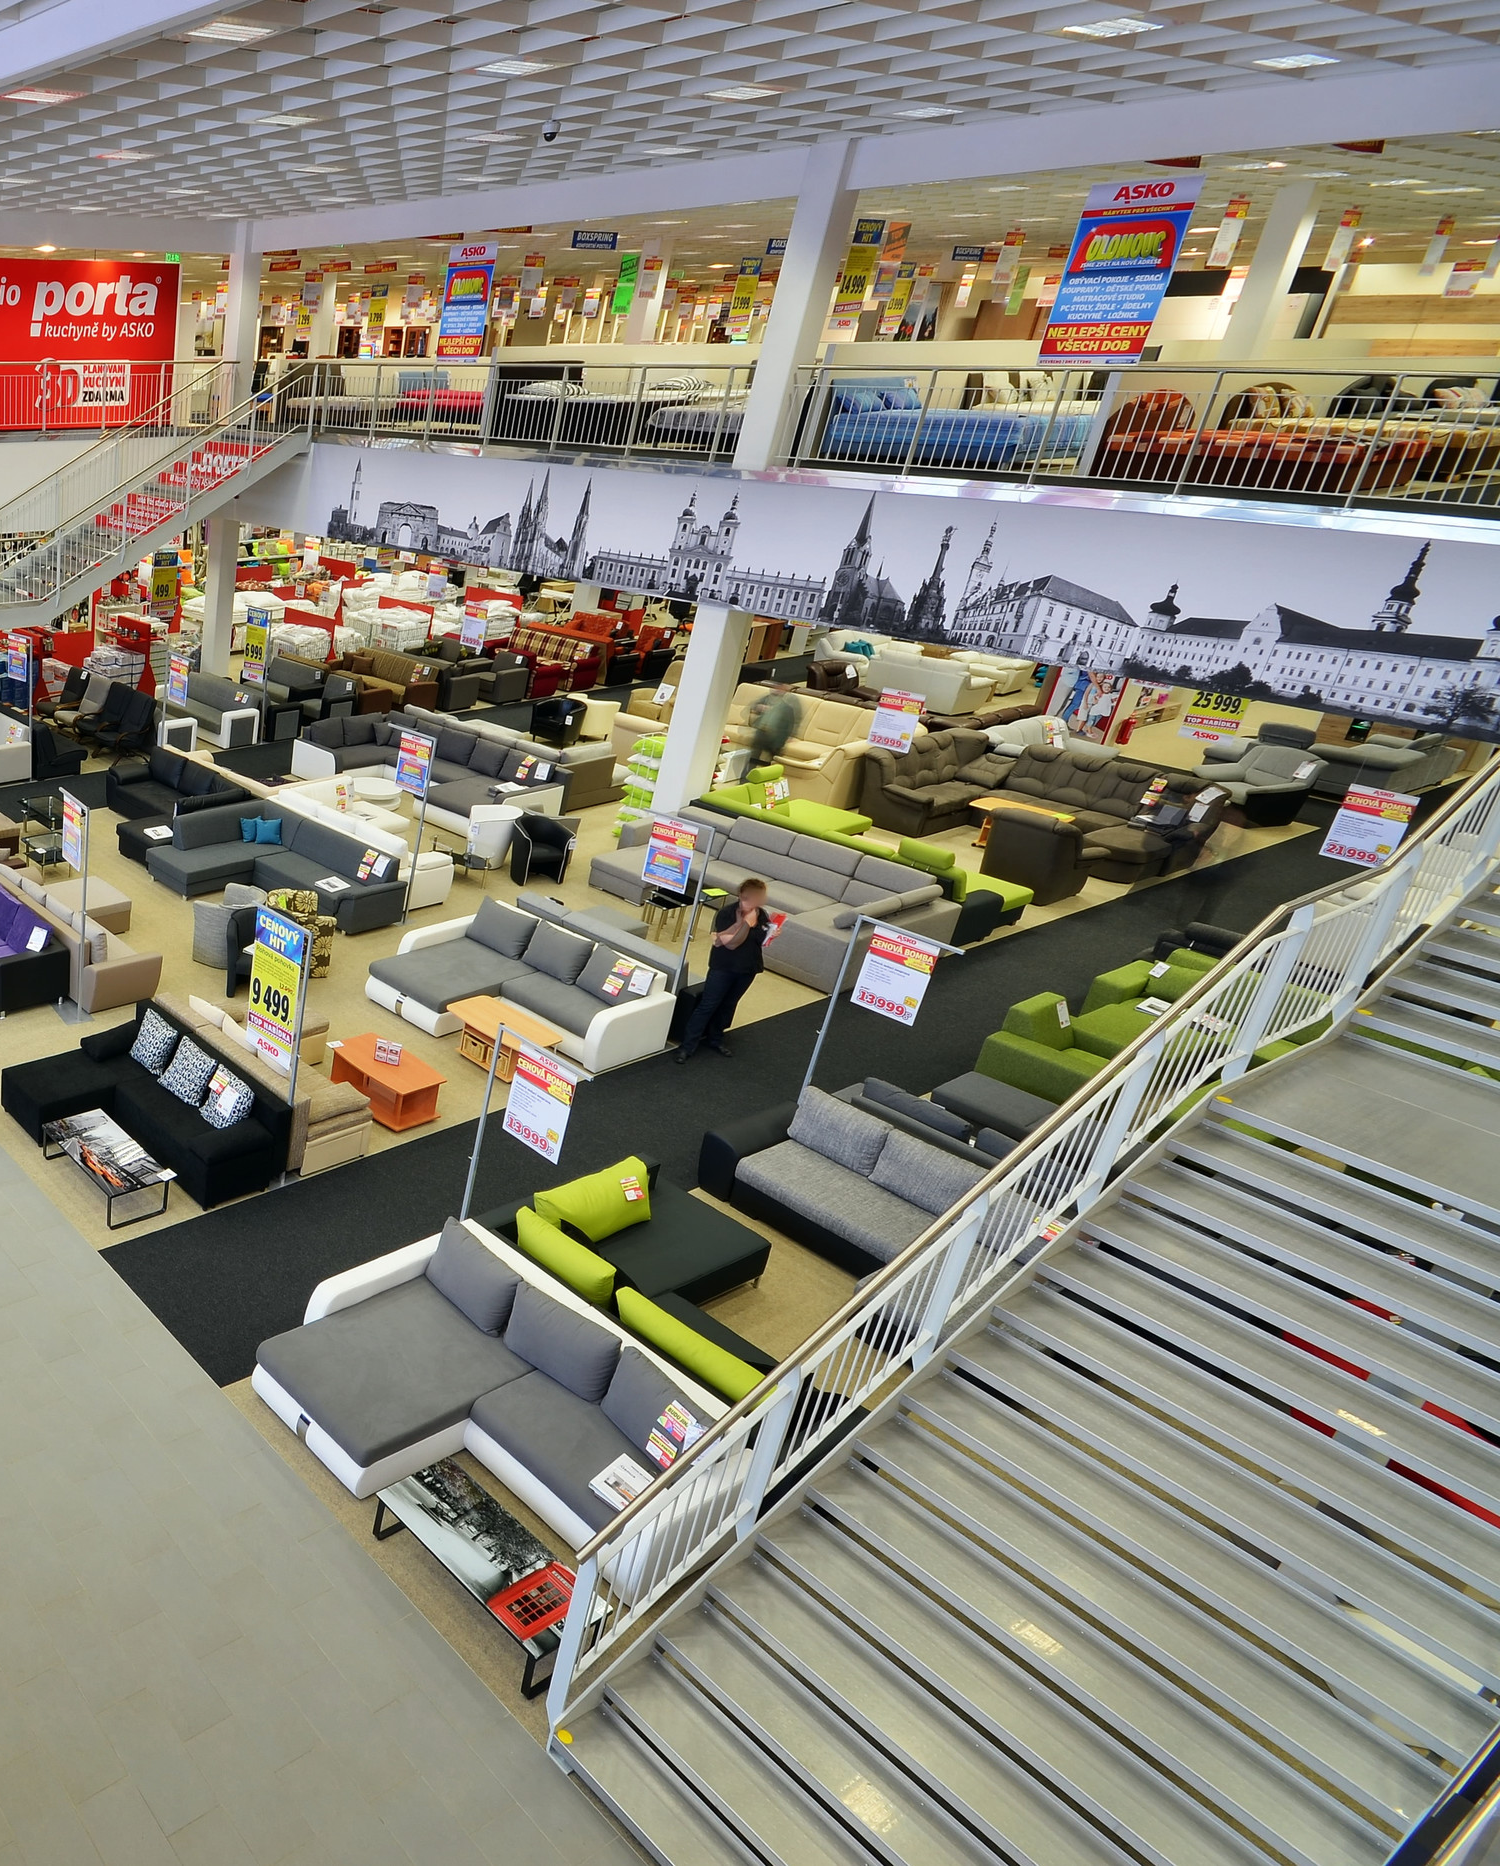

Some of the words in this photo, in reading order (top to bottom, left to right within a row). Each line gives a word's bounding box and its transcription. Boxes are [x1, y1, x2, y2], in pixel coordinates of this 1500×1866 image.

[1113, 182, 1175, 203] ASKO
[858, 222, 883, 232] CENOVÝ
[577, 232, 614, 242] BOXSPRING
[861, 233, 873, 243] HIT
[461, 246, 486, 259] ASKO
[1086, 231, 1167, 261] OLOMOUC
[1135, 273, 1163, 282] SEDACÍ
[32, 275, 158, 321] porta
[45, 322, 98, 341] kuchyně
[102, 322, 117, 341] by
[119, 323, 154, 337] ASKO
[1048, 323, 1110, 338] NEJLEPŠÍ
[1111, 325, 1150, 337] CENY
[1056, 339, 1098, 352] VŠECH
[1101, 340, 1131, 351] DOB
[83, 391, 125, 402] ZDARMA
[1187, 716, 1201, 725] TOP
[1203, 718, 1238, 729] NABÍDKA
[1192, 730, 1219, 741] ASKO
[1373, 790, 1395, 799] ASKO
[1345, 795, 1379, 808] CENOVÁ
[1380, 801, 1412, 814] BOMBA
[653, 825, 674, 837] CENOVÁ
[675, 831, 695, 842] BOMBA
[1325, 843, 1344, 856] 21
[259, 914, 300, 946] CENOVÝ
[269, 934, 287, 952] HIT
[896, 934, 917, 946] ASKO
[871, 938, 903, 954] CENOVÁ
[904, 948, 934, 964] BOMBA
[274, 954, 295, 973] pohovka
[252, 977, 262, 1005] 9
[857, 988, 876, 1005] 13
[250, 1014, 263, 1028] TOP
[263, 1020, 291, 1044] NABÍDKA
[257, 1037, 279, 1058] ASKO
[539, 1055, 559, 1070] ASKO
[517, 1057, 545, 1078] CENOVÁ
[546, 1070, 573, 1094] BOMBA
[506, 1113, 522, 1134] 13
